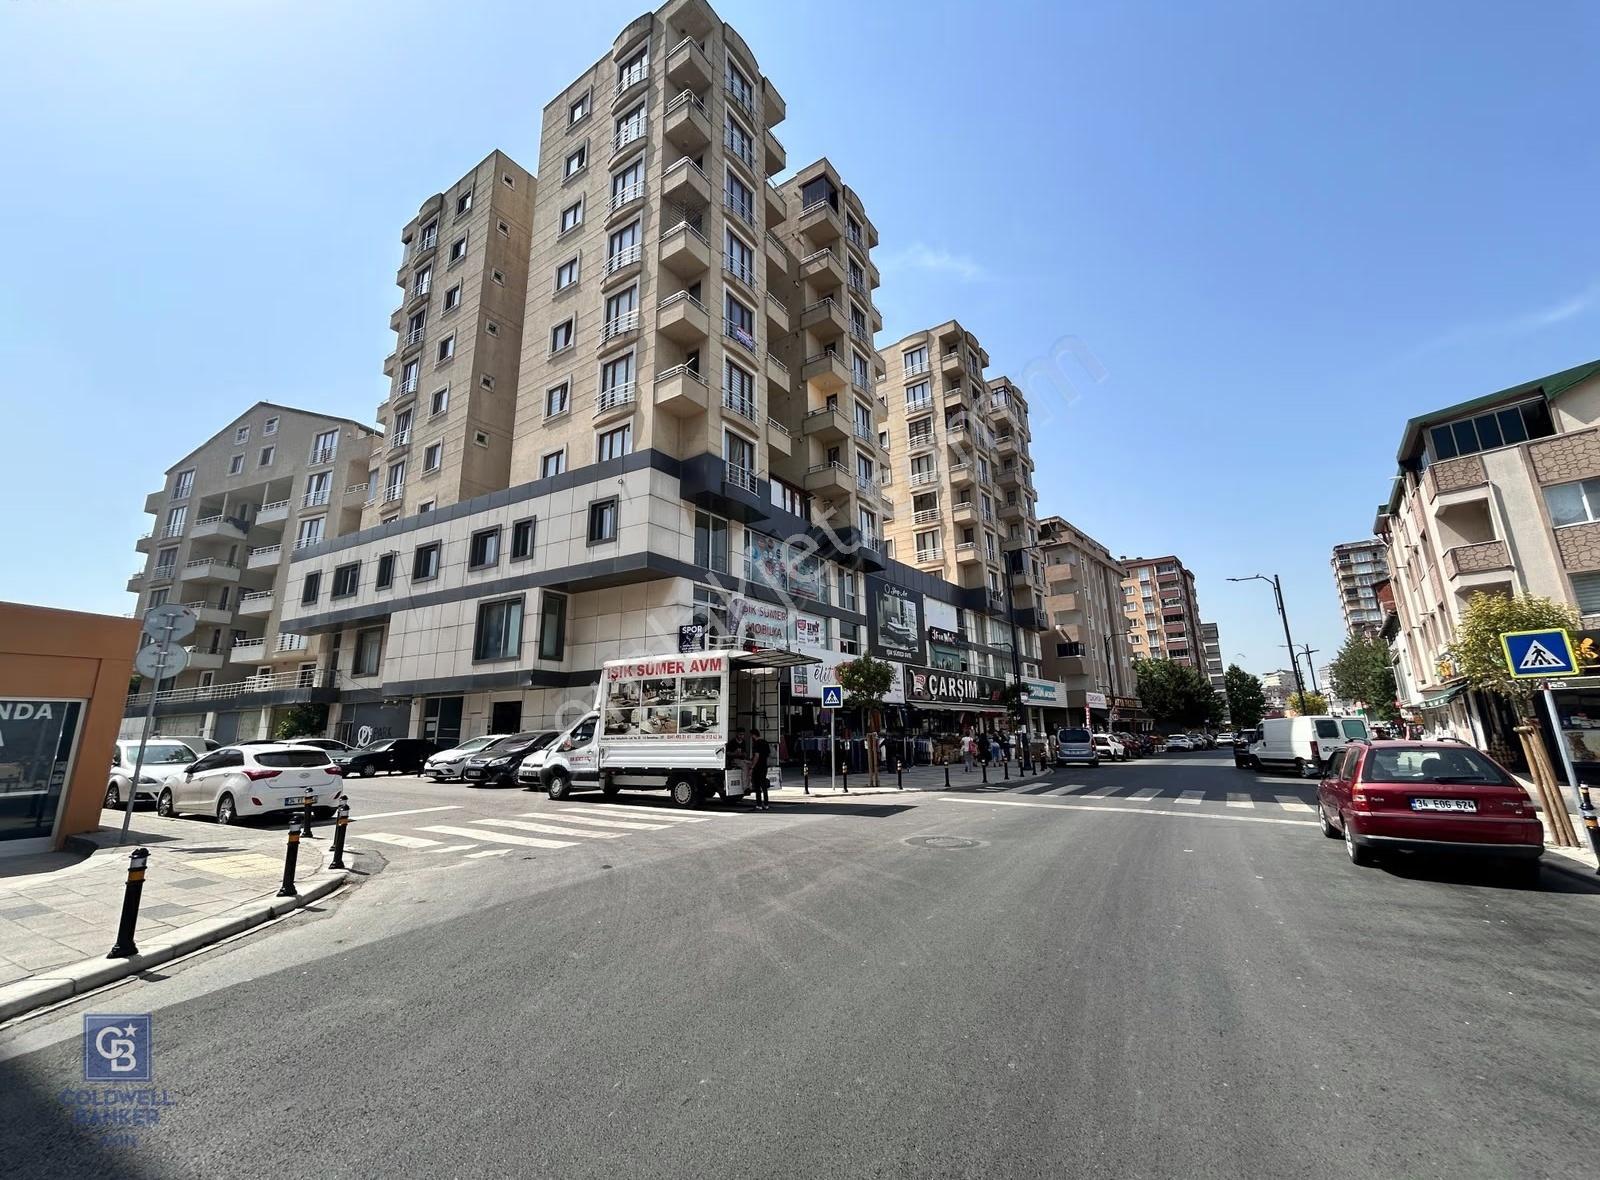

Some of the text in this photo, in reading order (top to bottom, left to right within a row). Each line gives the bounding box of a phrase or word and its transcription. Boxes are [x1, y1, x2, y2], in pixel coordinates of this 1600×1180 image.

[682, 625, 702, 634] SPOR
[690, 658, 722, 672] AVM
[928, 675, 978, 702] ÇARŞIM
[1416, 799, 1428, 808] 34
[1457, 800, 1475, 810] 624
